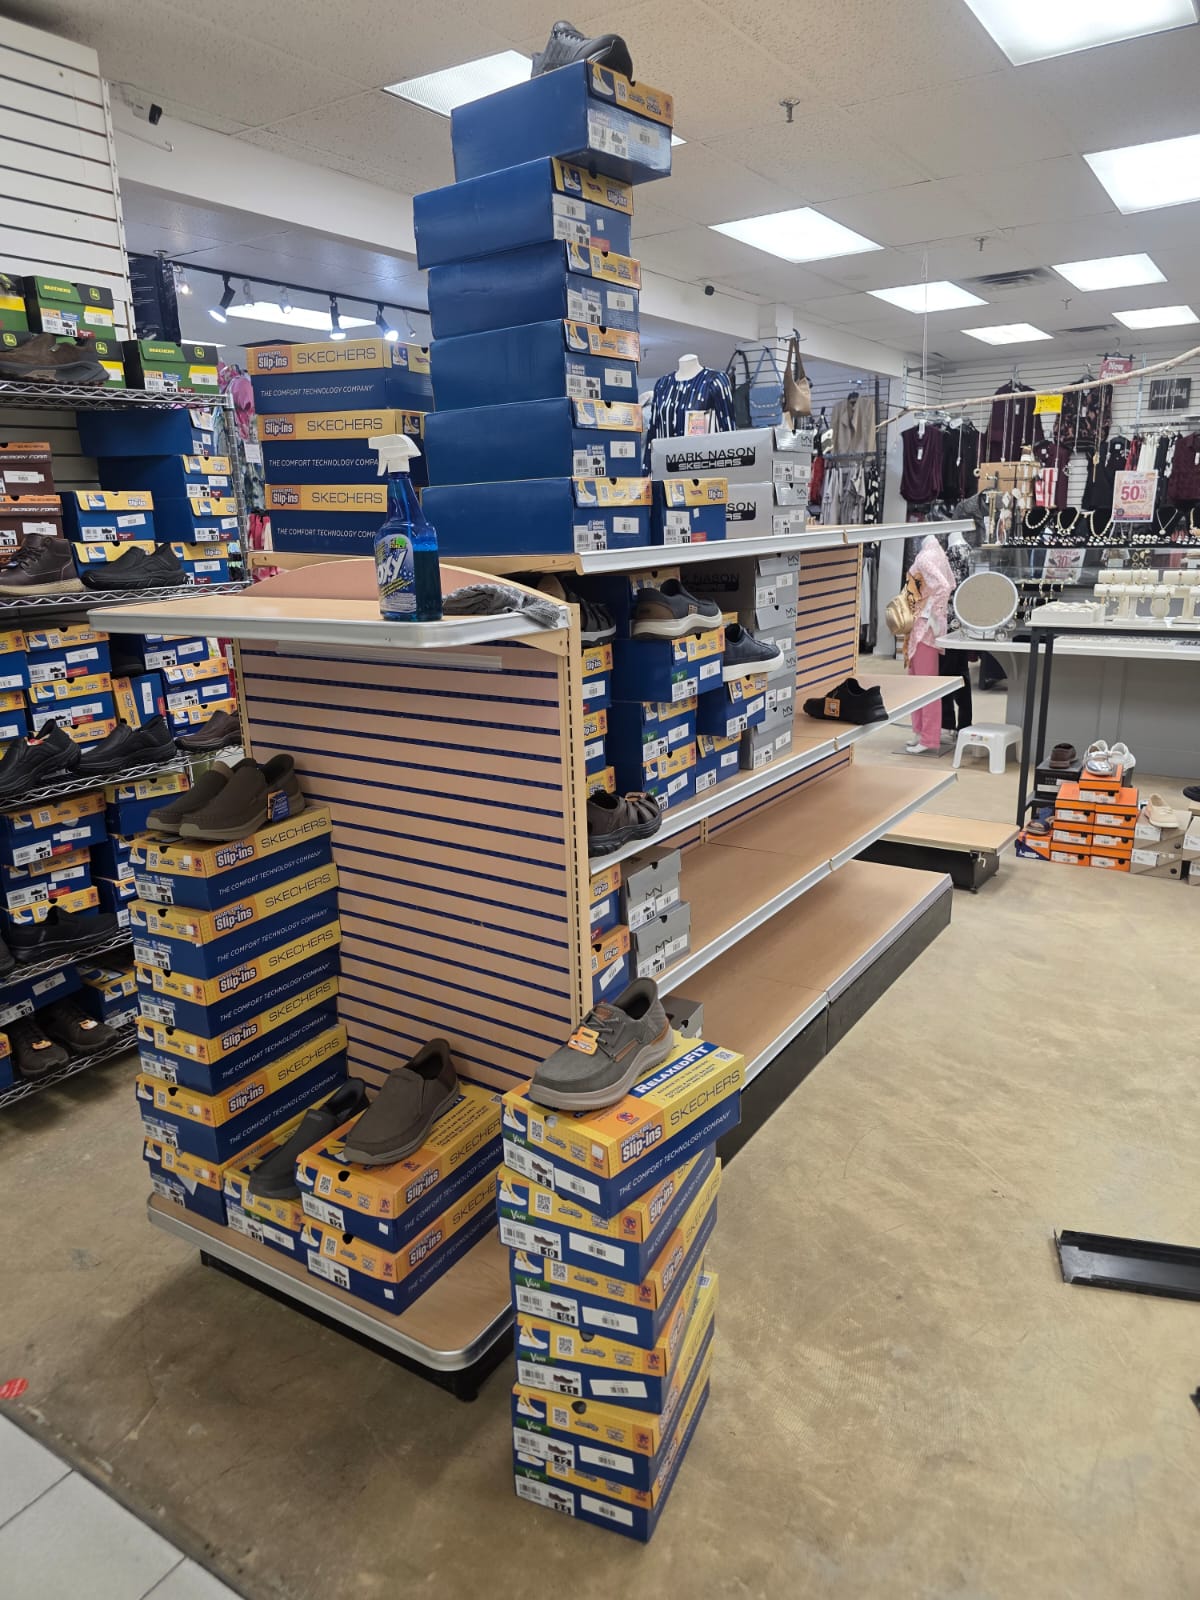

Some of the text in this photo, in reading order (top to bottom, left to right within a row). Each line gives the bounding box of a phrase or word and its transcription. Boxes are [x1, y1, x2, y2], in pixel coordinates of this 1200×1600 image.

[257, 355, 288, 370] Slip-ins
[297, 348, 376, 365] SKECHERS
[273, 388, 301, 397] COMFORT
[302, 387, 342, 396] TECHNOLOGY
[343, 385, 374, 393] COMPANY
[264, 421, 293, 435] Slip-ins
[307, 418, 383, 432] SKECHERS
[269, 459, 280, 467] THE
[281, 459, 310, 467] COMFORT
[666, 447, 756, 463] MARK NASON
[678, 458, 742, 471] SKECHERS
[272, 492, 299, 505] Slip-ins
[312, 492, 383, 504] SKECHERS
[726, 502, 756, 511] SON
[288, 528, 316, 536] COMFORT
[317, 529, 357, 537] TECHNOLOGY
[261, 817, 327, 848] SKECHERS
[217, 846, 254, 868] Slip-ins
[219, 887, 230, 895] THE
[231, 874, 258, 890] COMFORT
[260, 861, 295, 879] TECHNOLOGY
[265, 873, 331, 907] SKECHERS
[216, 908, 252, 931] Slip-ins
[217, 909, 328, 963] THE COMFORT TECHNOLOGY COMPANY
[268, 930, 334, 967] SKECHERS
[220, 968, 256, 992] Slip-ins
[220, 1013, 231, 1022] THE
[233, 997, 262, 1015] COMFORT
[264, 978, 302, 999] TECHNOLOGY
[269, 983, 331, 1021] SKECHERS
[222, 1016, 327, 1078] THE COMFORT TECHNOLOGY COMPANY
[223, 1025, 257, 1050] Slip-ins
[278, 1038, 340, 1080] SKECHERS
[229, 1085, 264, 1112] Slip-ins
[242, 1115, 271, 1136] COMFORT
[273, 1091, 310, 1116] TECHNOLOGY
[310, 1073, 337, 1093] COMPANY
[671, 1070, 741, 1126] SKECHERS
[449, 1118, 501, 1165] SKECHER
[619, 1181, 631, 1196] THE
[632, 1159, 663, 1187] COMFORT
[664, 1131, 702, 1162] TECHNOLOGY
[702, 1111, 731, 1136] COMPANY
[622, 1125, 663, 1163] Slip-ins
[406, 1169, 439, 1203] Slip-ins
[453, 1182, 496, 1224] SKECHE
[649, 1181, 673, 1224] Slip-ins
[409, 1231, 442, 1265] Slip-ins
